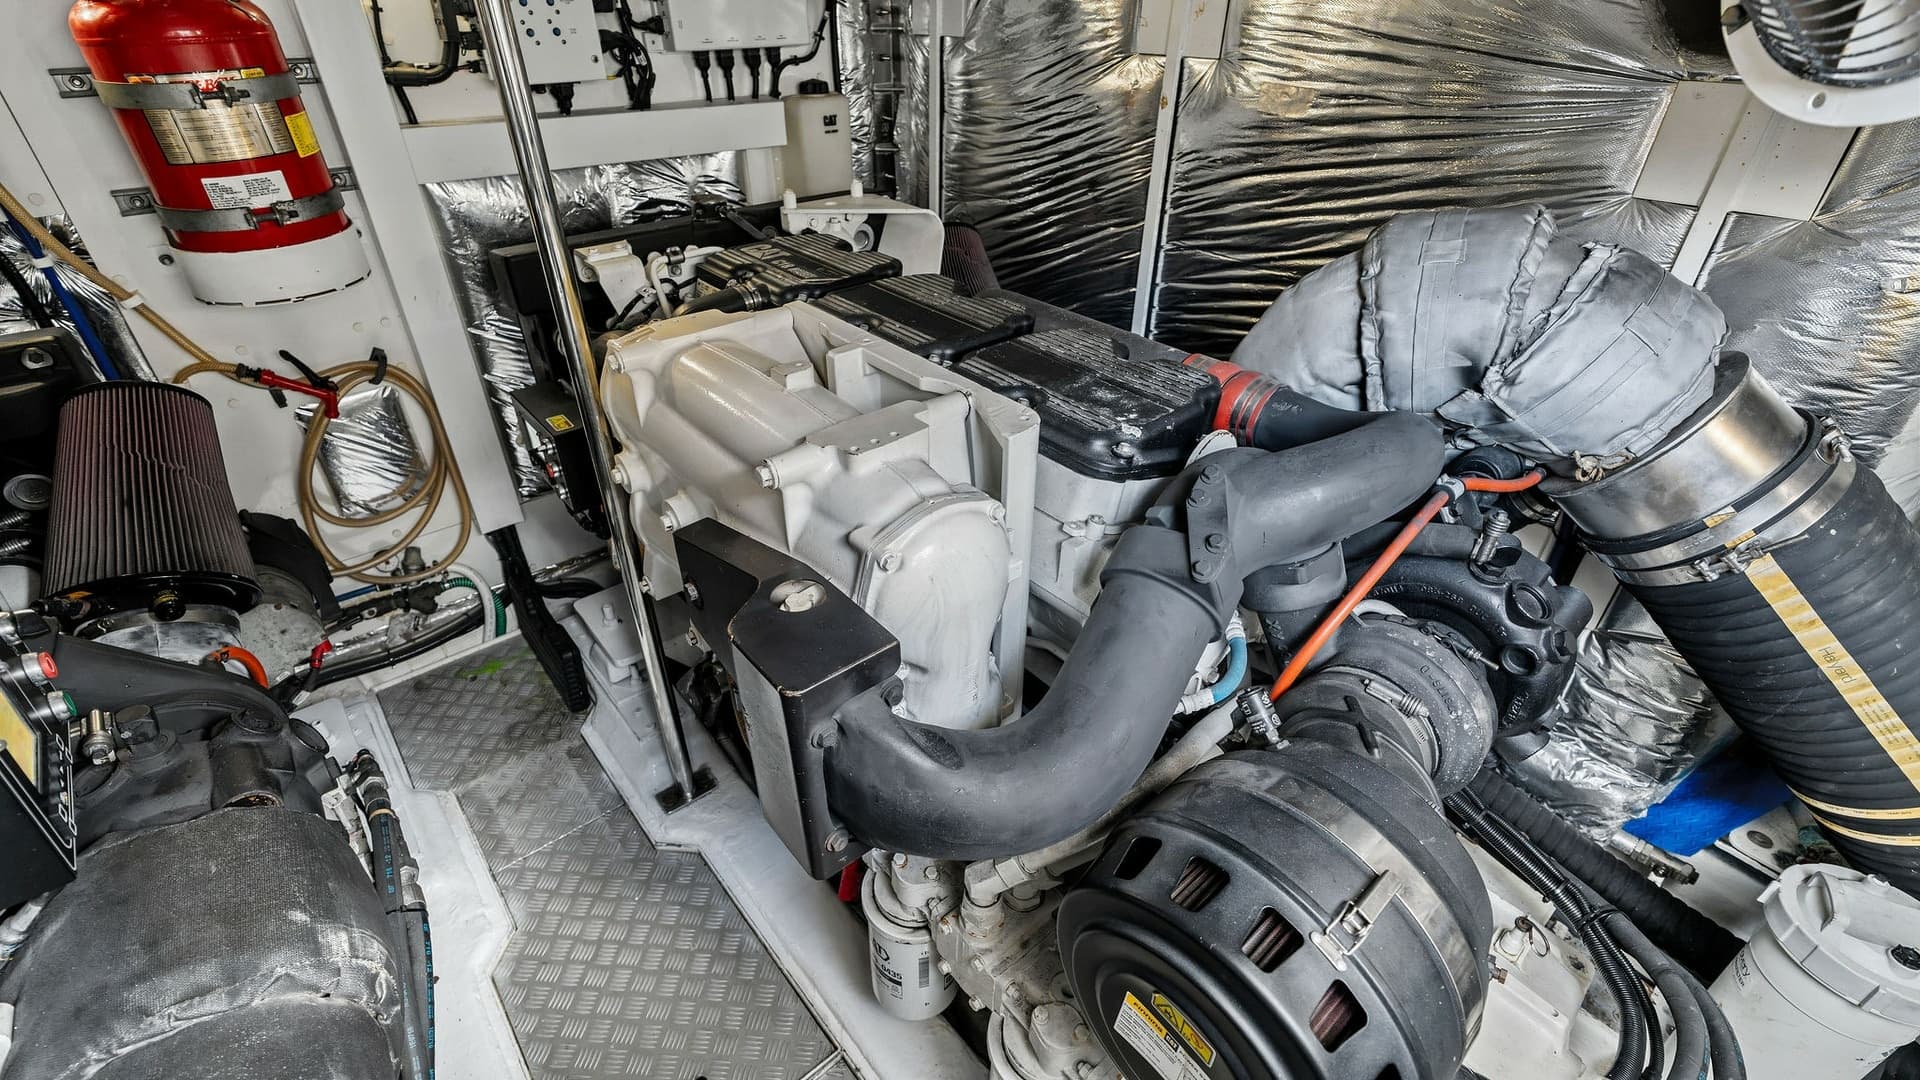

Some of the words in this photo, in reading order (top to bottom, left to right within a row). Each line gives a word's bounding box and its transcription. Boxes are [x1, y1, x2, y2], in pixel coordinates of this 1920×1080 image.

[823, 114, 837, 127] CAT
[740, 243, 794, 261] CAT
[1818, 646, 1857, 685] Halyard
[1165, 1034, 1178, 1049] CAT
